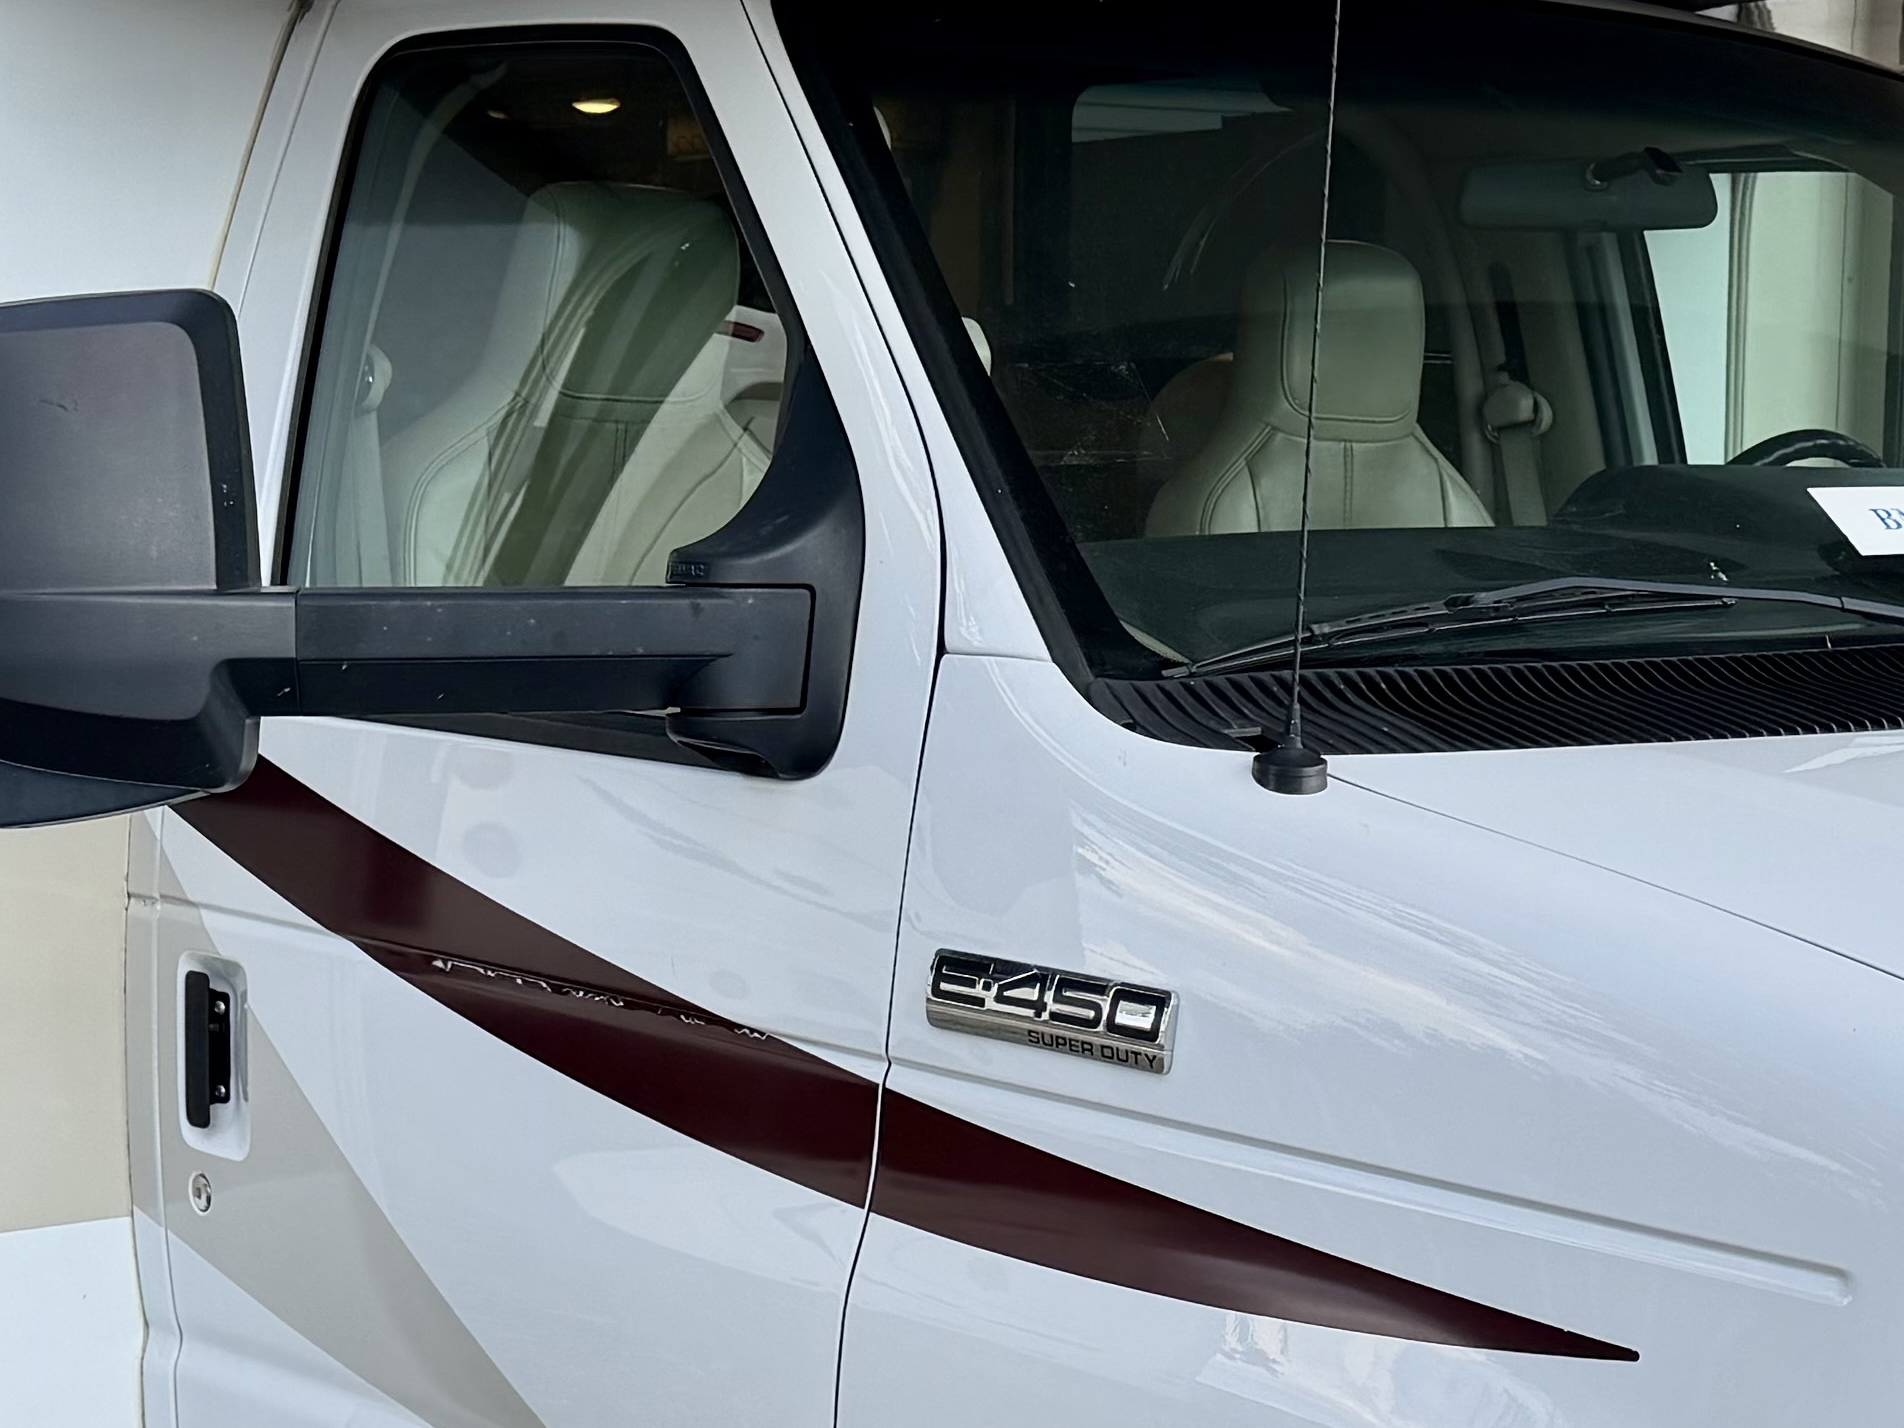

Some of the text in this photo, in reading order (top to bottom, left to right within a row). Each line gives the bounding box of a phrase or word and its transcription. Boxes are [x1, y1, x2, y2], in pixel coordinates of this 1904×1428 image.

[929, 954, 1168, 1044] E-450
[1027, 1029, 1158, 1070] SUPER DUTY
